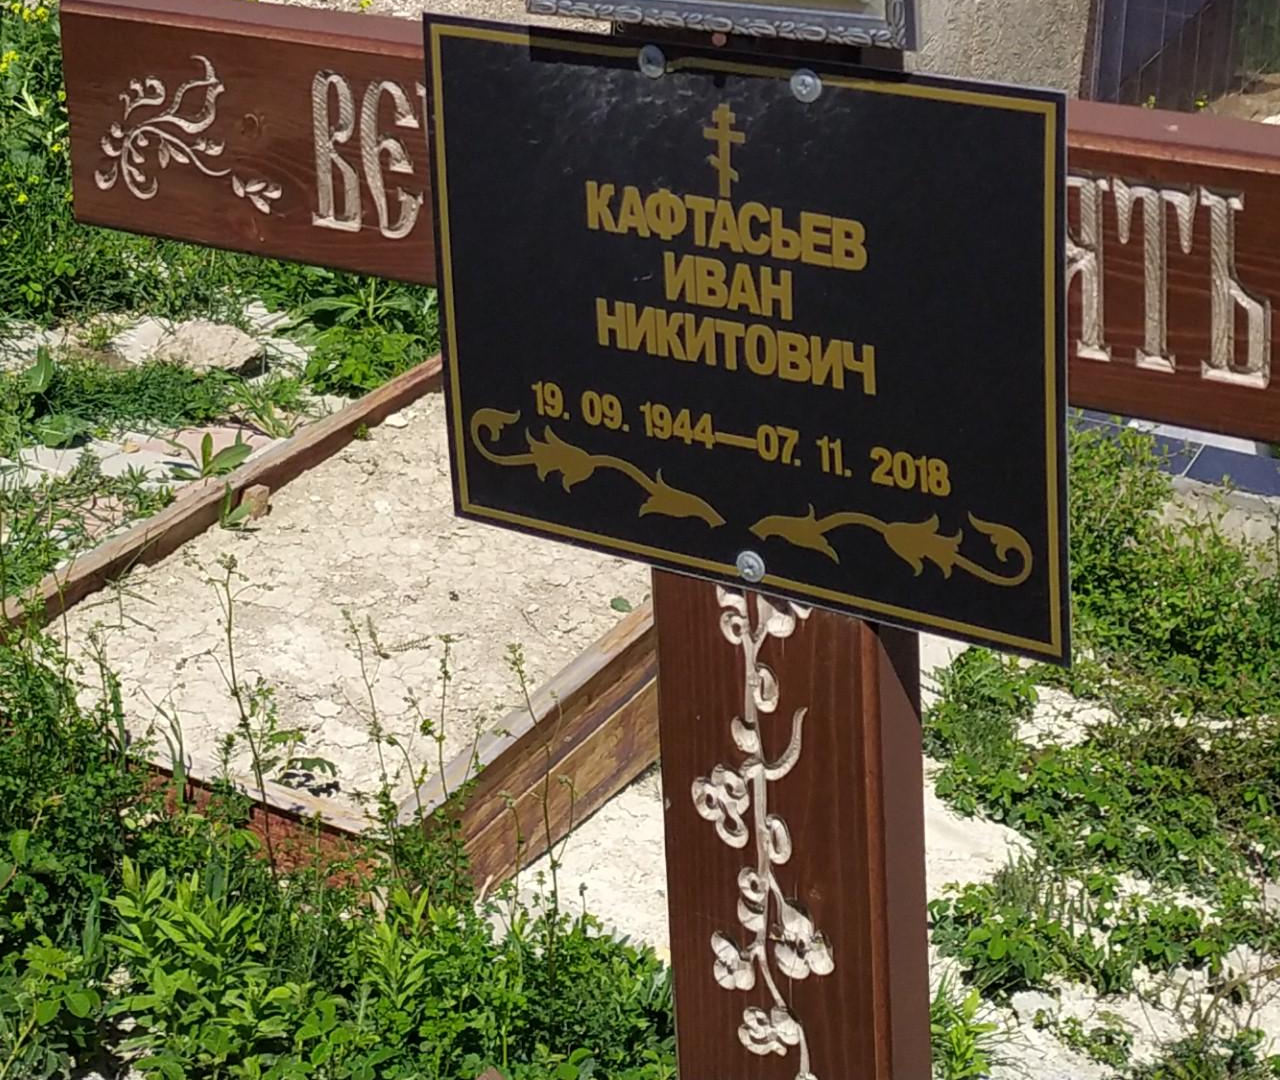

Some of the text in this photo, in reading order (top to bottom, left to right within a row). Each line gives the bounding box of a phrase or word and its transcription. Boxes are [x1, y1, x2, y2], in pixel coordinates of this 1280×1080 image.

[311, 68, 427, 240] ВЕ
[585, 180, 868, 271] КАФТАСЬЕВ
[663, 251, 794, 321] ИВАН
[595, 297, 877, 396] НИКИТОВИЧ
[531, 381, 569, 418] 19.
[581, 390, 628, 432] 09.
[817, 438, 852, 477] 11.
[869, 446, 952, 497] 2018
